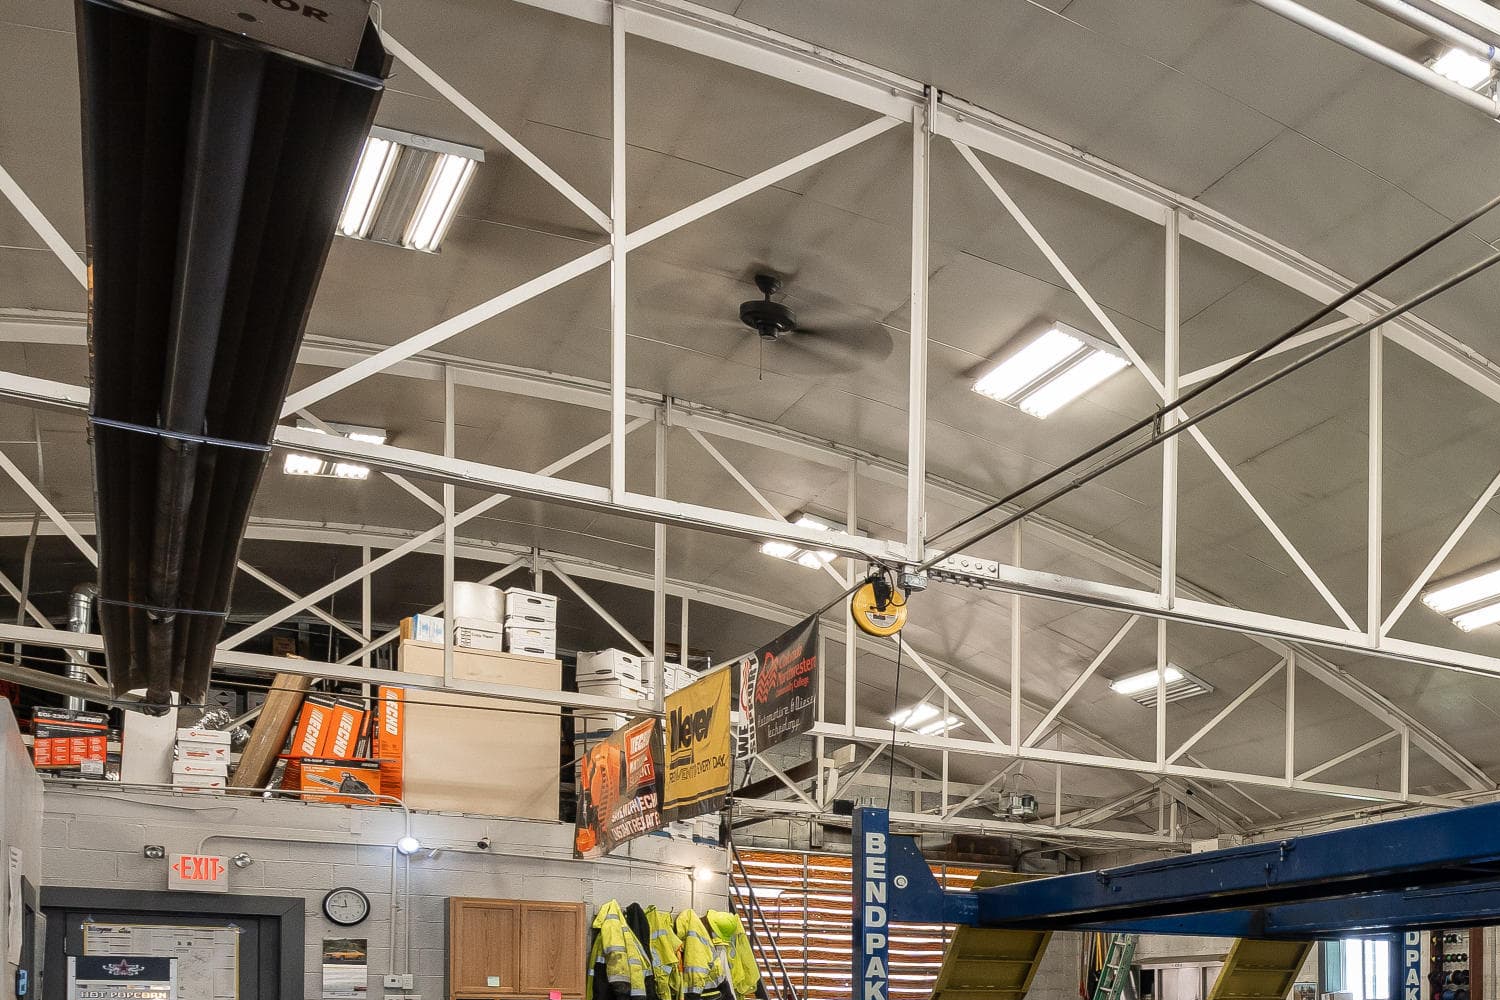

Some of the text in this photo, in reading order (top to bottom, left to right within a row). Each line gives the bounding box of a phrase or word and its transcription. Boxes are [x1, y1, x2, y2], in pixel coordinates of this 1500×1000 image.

[301, 707, 323, 756] ECHO
[333, 710, 354, 758] ECHO
[737, 725, 750, 758] WE
[179, 856, 220, 881] EXIT
[80, 991, 167, 999] HOT POPCORN
